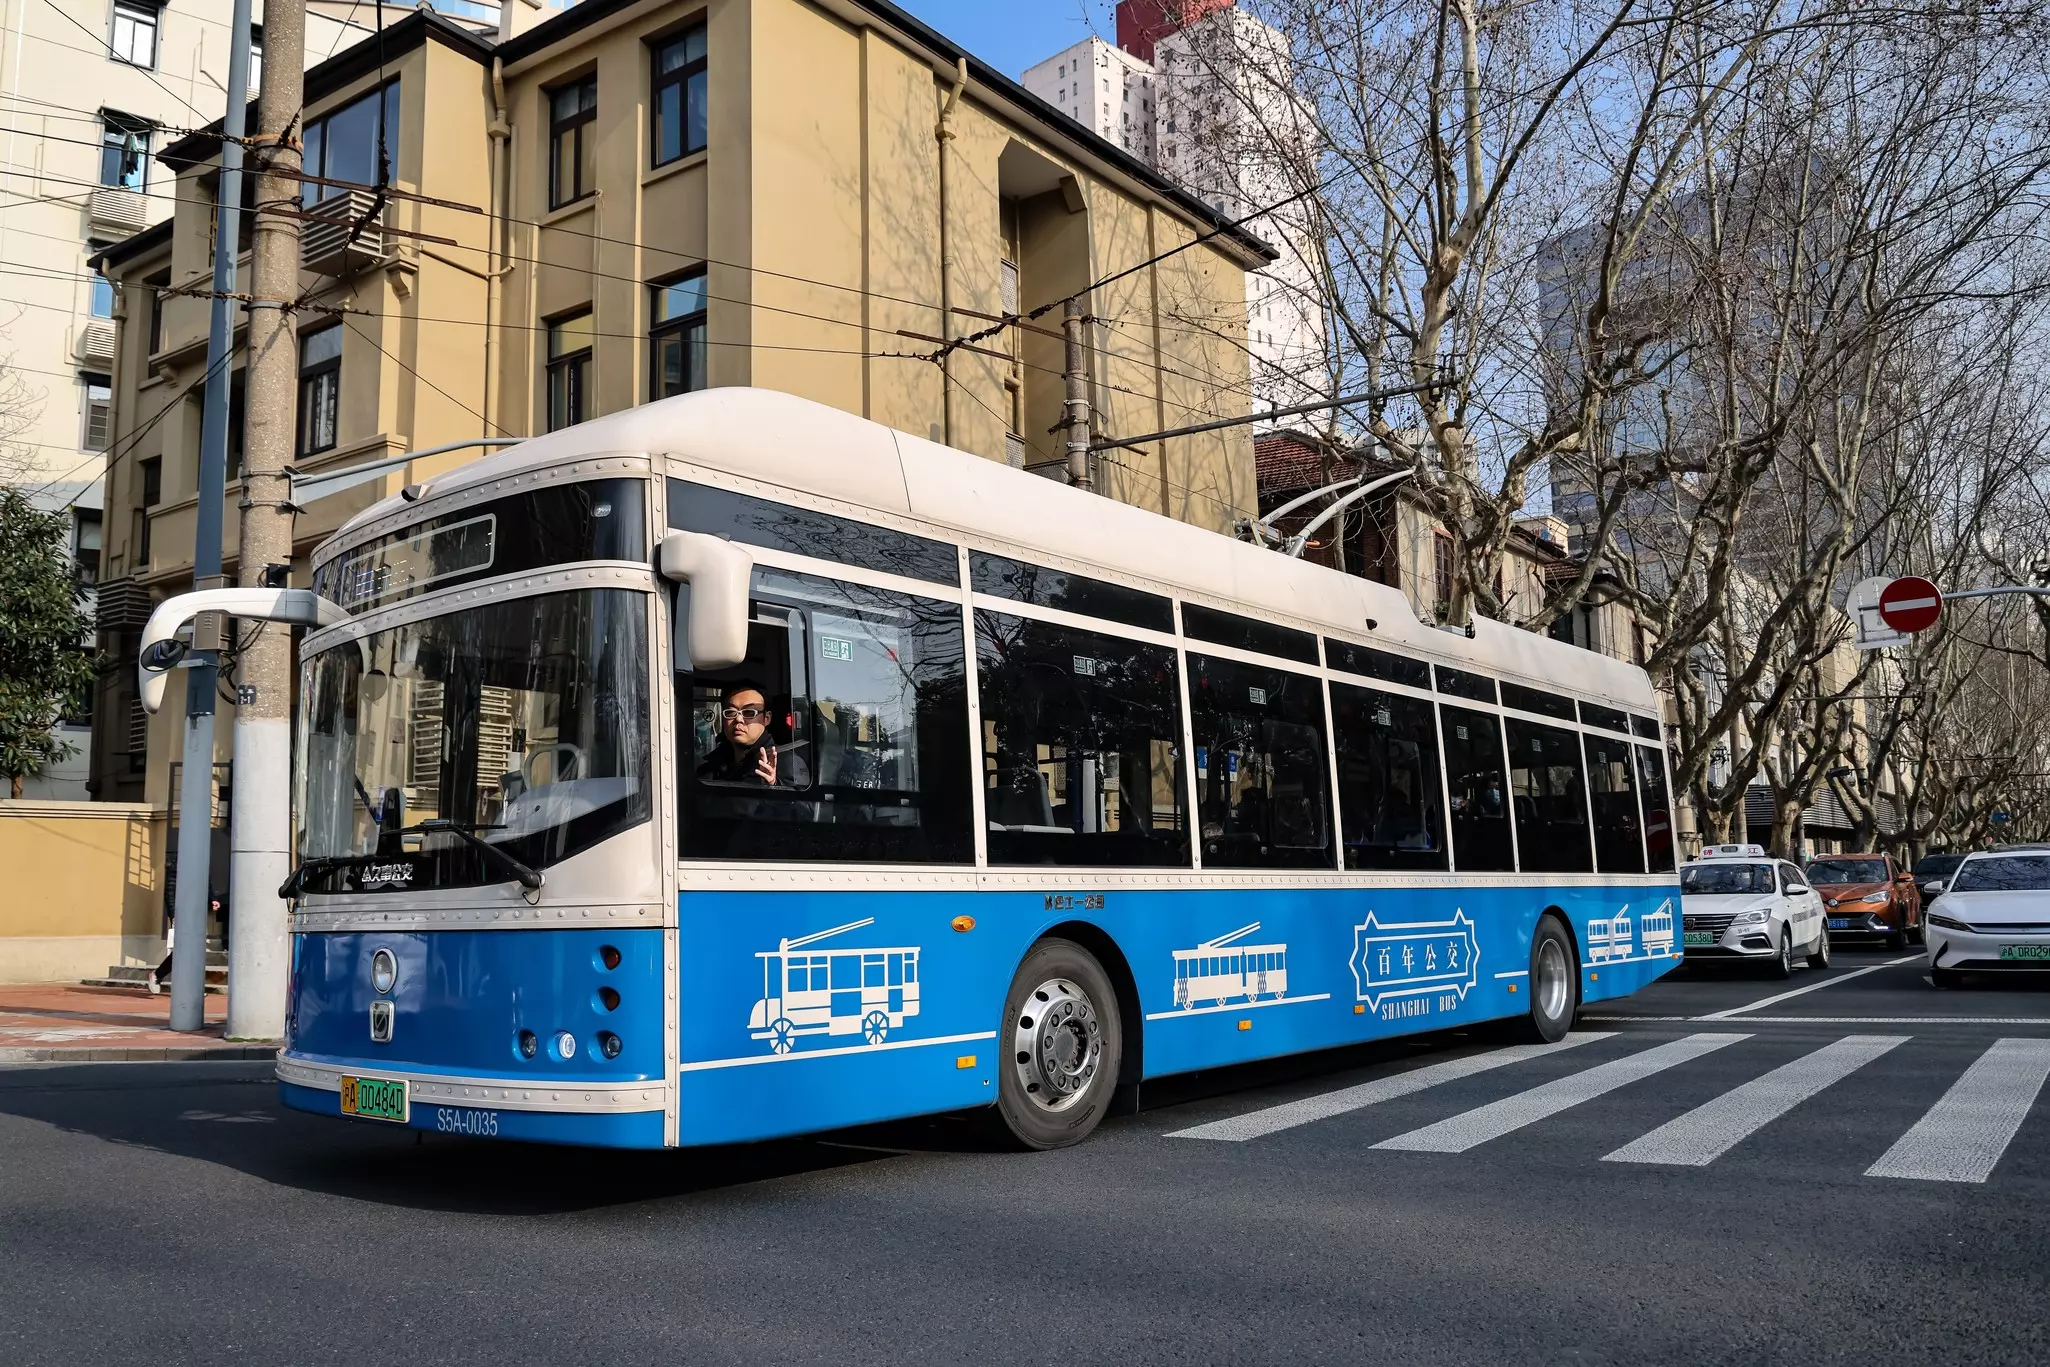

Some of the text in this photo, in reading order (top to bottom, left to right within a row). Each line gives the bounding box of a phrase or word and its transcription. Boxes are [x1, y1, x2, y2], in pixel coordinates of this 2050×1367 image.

[1377, 940, 1458, 976] 百年公交
[1381, 994, 1457, 1021] SHANGHAI BUS
[437, 1107, 498, 1136] S5A-0035
